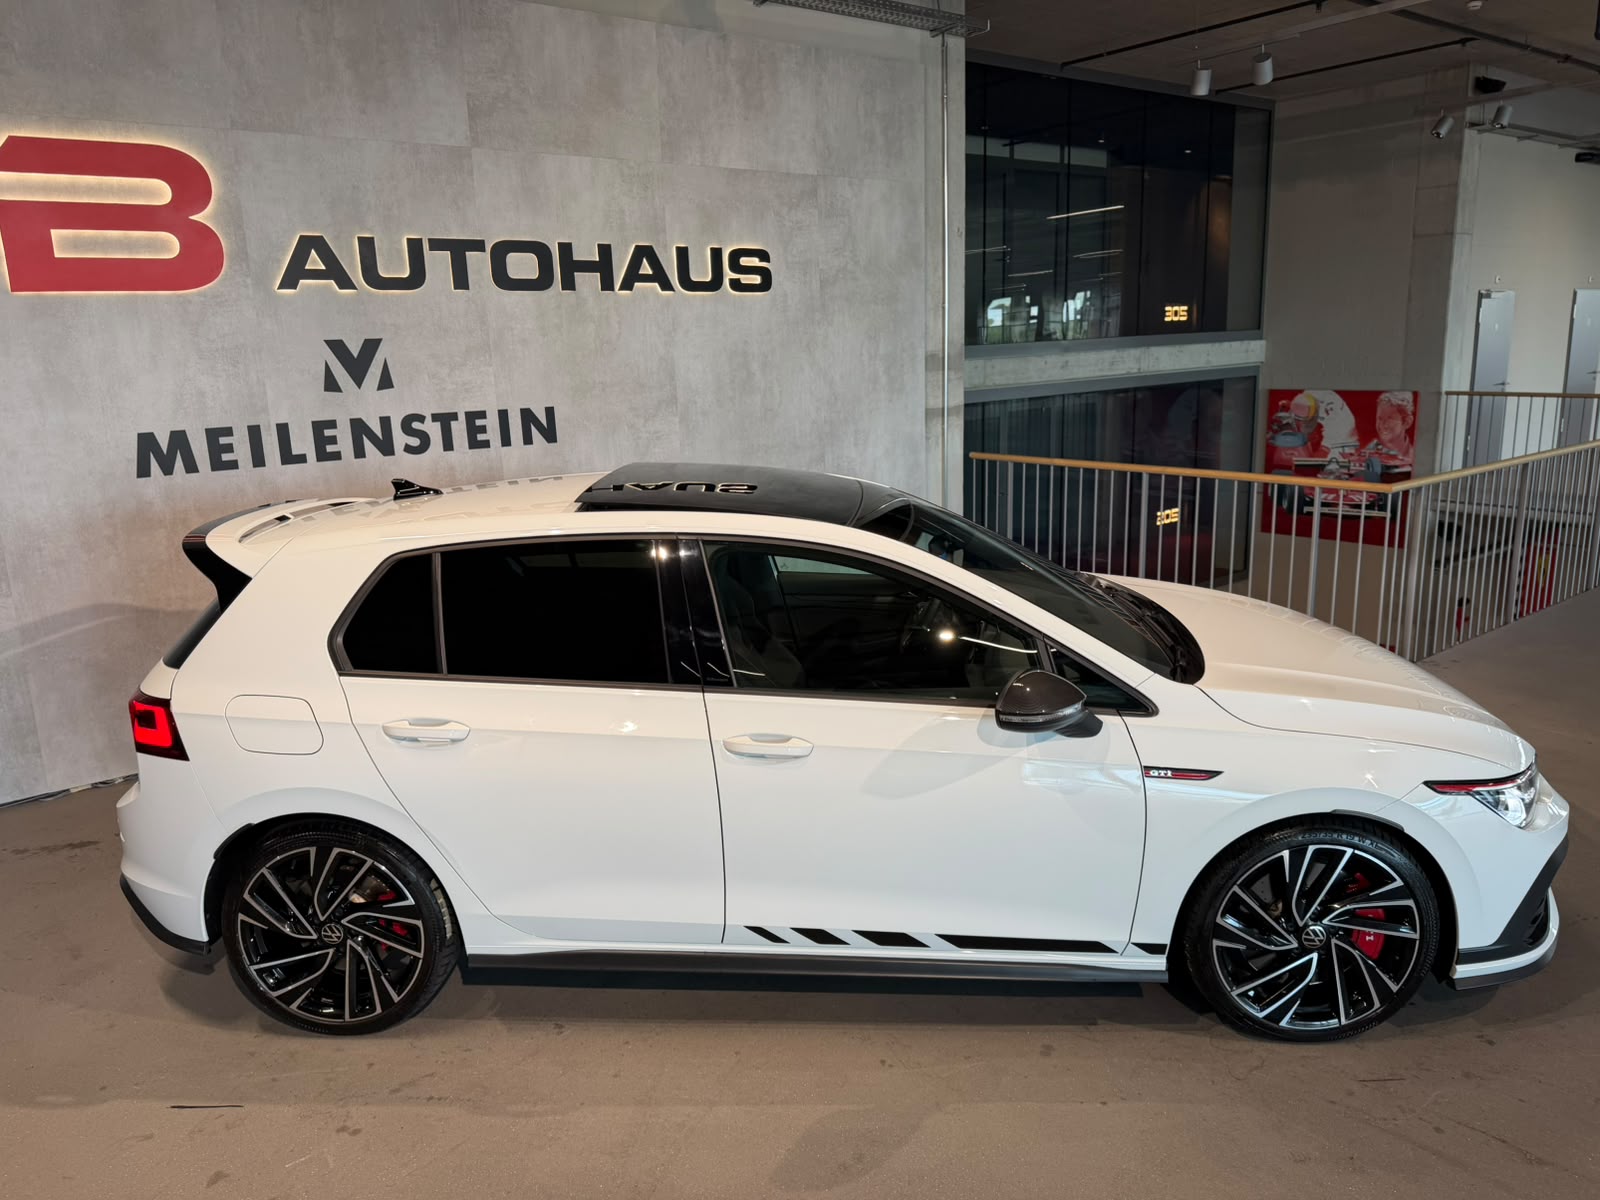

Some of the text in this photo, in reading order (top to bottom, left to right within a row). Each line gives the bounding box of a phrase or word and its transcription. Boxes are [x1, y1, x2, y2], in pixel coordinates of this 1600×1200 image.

[0, 135, 773, 293] B AUTOHAUS
[1164, 305, 1188, 321] 305
[136, 406, 558, 478] MEILENSTEIN
[1149, 769, 1173, 777] GTI
